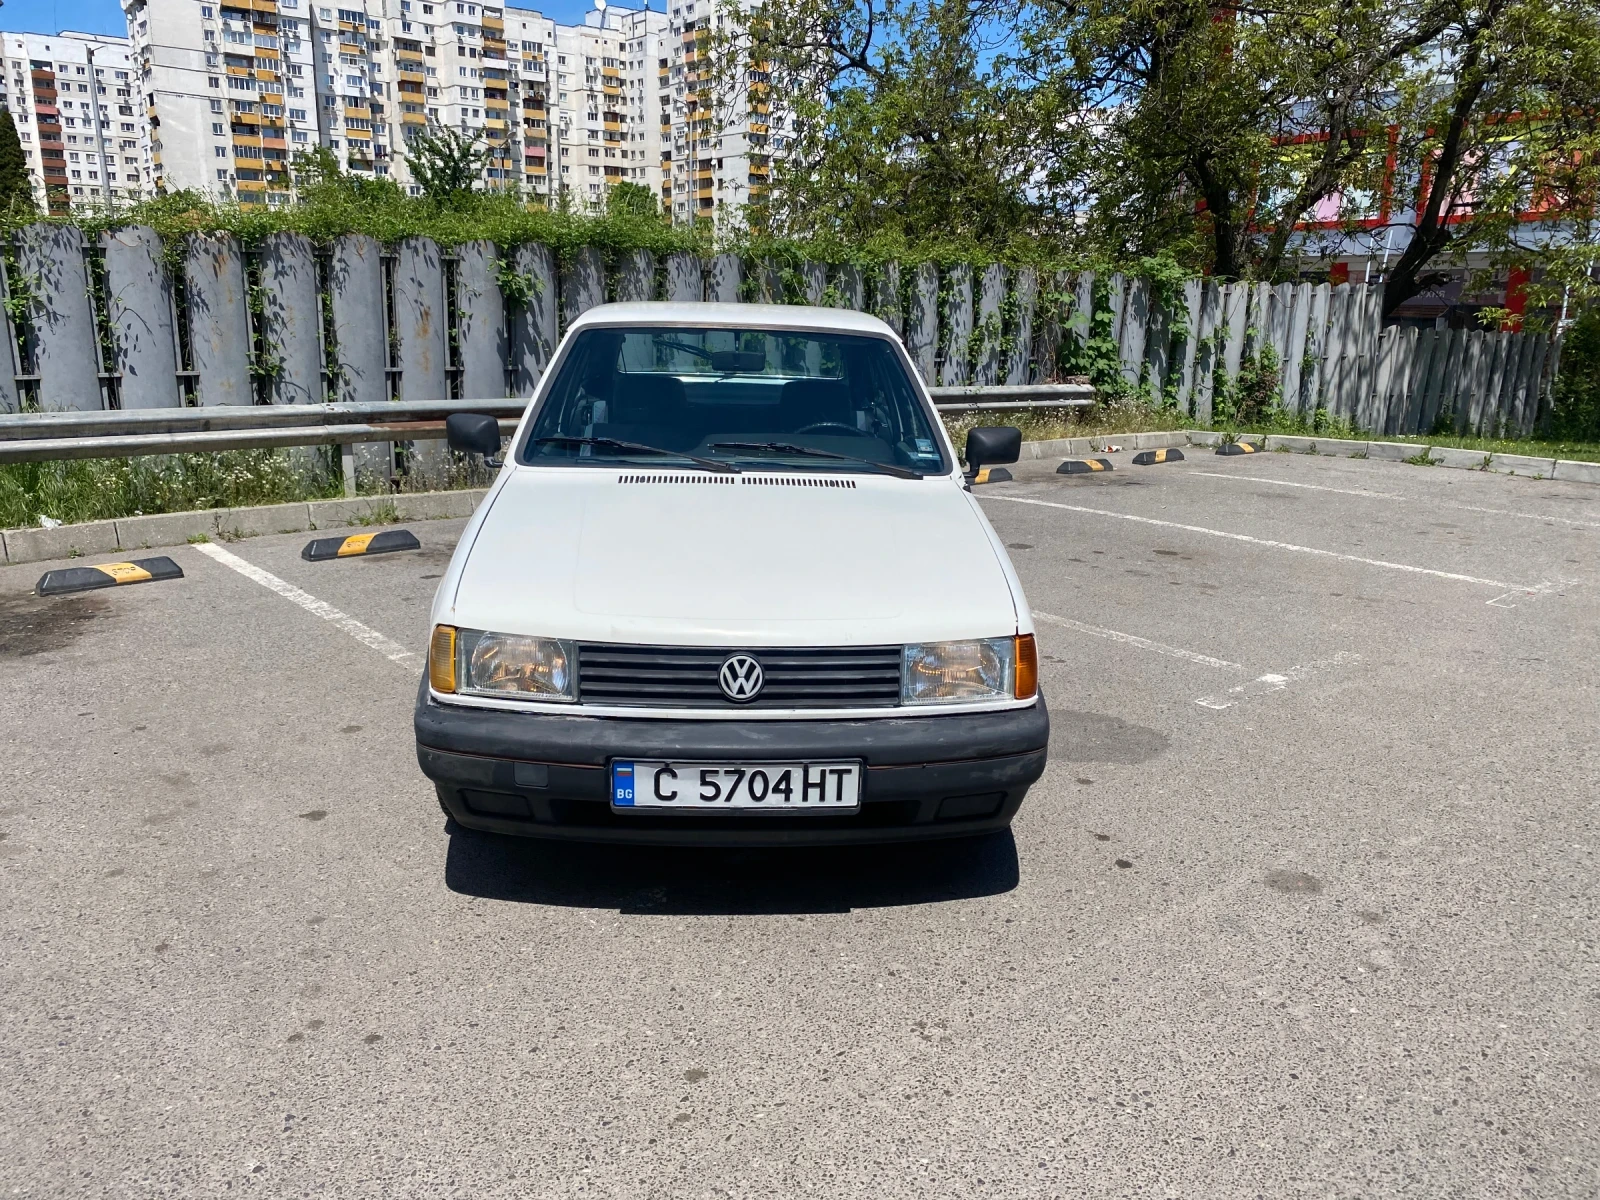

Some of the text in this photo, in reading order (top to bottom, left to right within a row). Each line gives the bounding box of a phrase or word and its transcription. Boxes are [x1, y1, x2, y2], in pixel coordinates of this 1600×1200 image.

[1414, 290, 1446, 299] УХНЯ
[720, 655, 762, 699] VW
[616, 788, 633, 799] BG
[653, 767, 853, 802] C 5704 HT
